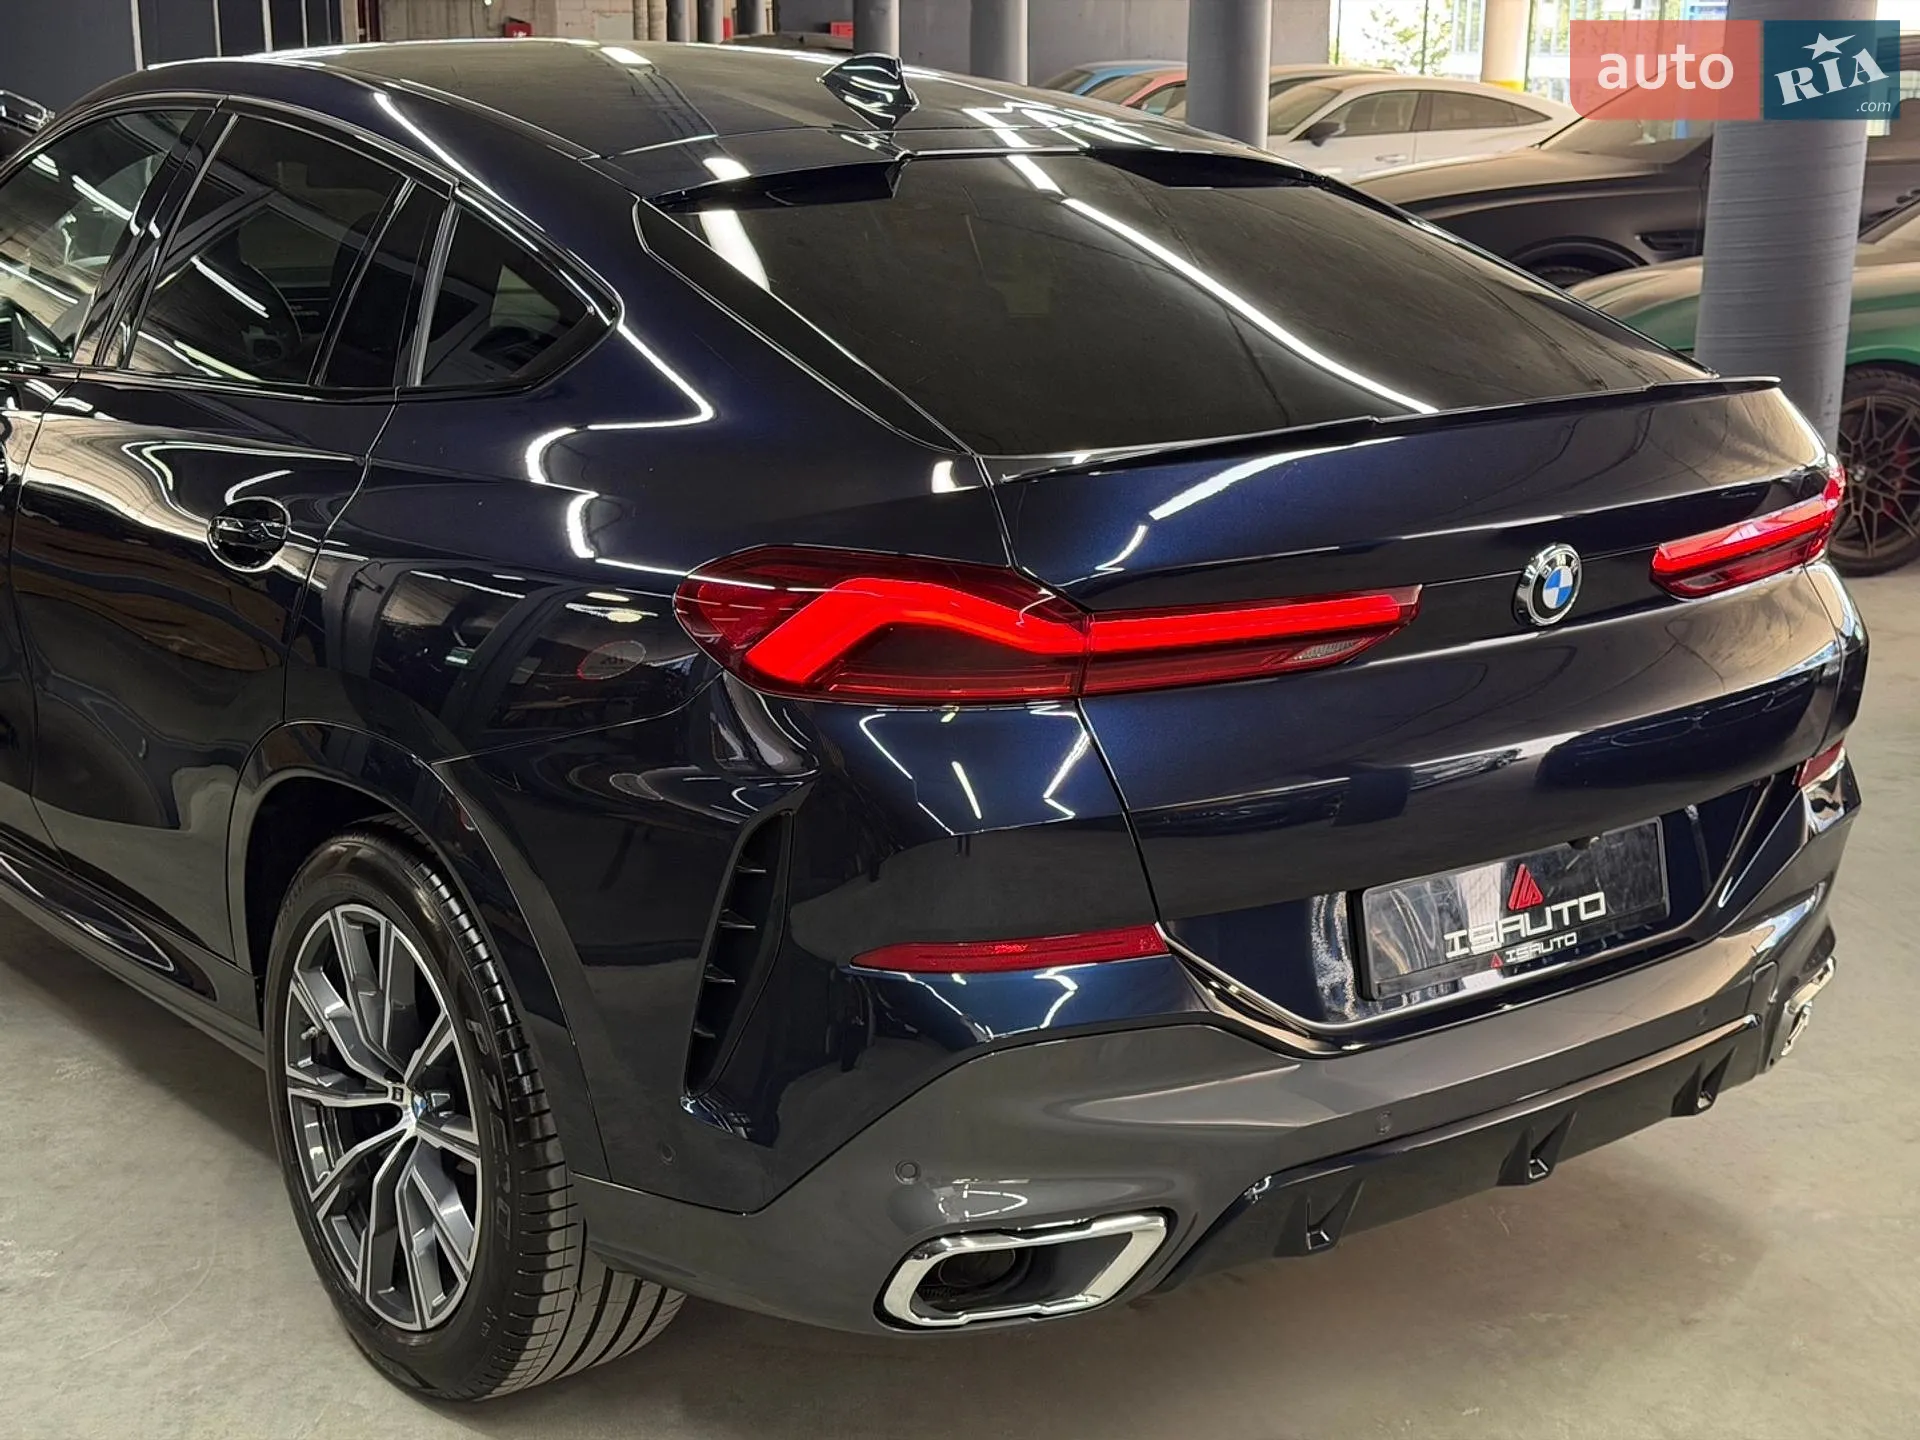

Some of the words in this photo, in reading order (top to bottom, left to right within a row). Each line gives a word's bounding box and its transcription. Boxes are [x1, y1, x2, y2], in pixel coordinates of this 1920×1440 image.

[1540, 553, 1579, 578] BMW
[1444, 891, 1606, 958] ISAUTO
[1505, 933, 1578, 963] ISAUTO
